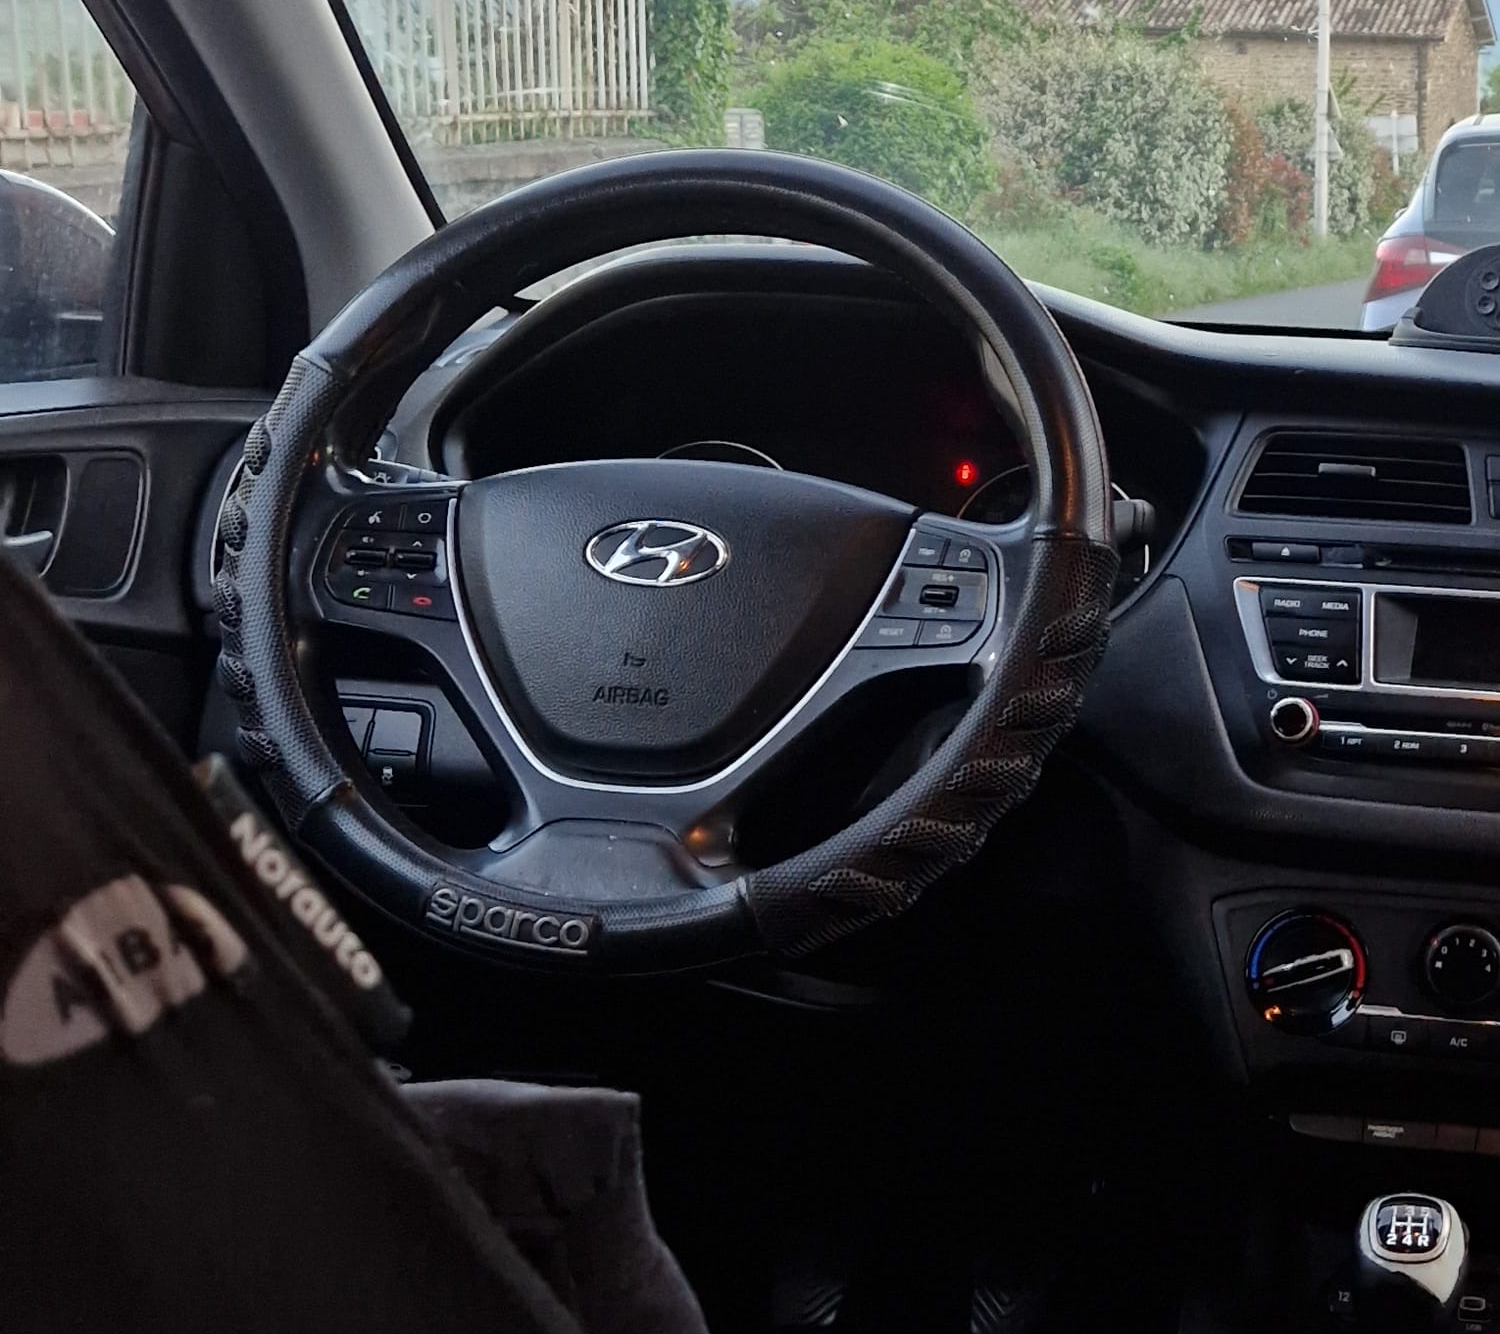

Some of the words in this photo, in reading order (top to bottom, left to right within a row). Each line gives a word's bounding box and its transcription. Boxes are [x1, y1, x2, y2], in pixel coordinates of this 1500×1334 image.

[1274, 599, 1300, 608] RADIO
[1322, 602, 1349, 610] MEDIA
[1299, 628, 1328, 638] PHONE
[1304, 661, 1330, 669] TRACK
[592, 686, 669, 706] AIRBAG
[1394, 739, 1401, 749] 2
[1460, 744, 1468, 754] 3
[230, 812, 382, 989] Norauto
[429, 888, 589, 949] sparco
[1449, 1037, 1468, 1048] A/C
[1386, 1233, 1397, 1245] 2
[1402, 1234, 1412, 1246] 4
[1417, 1234, 1429, 1247] R
[1338, 1290, 1351, 1303] 12
